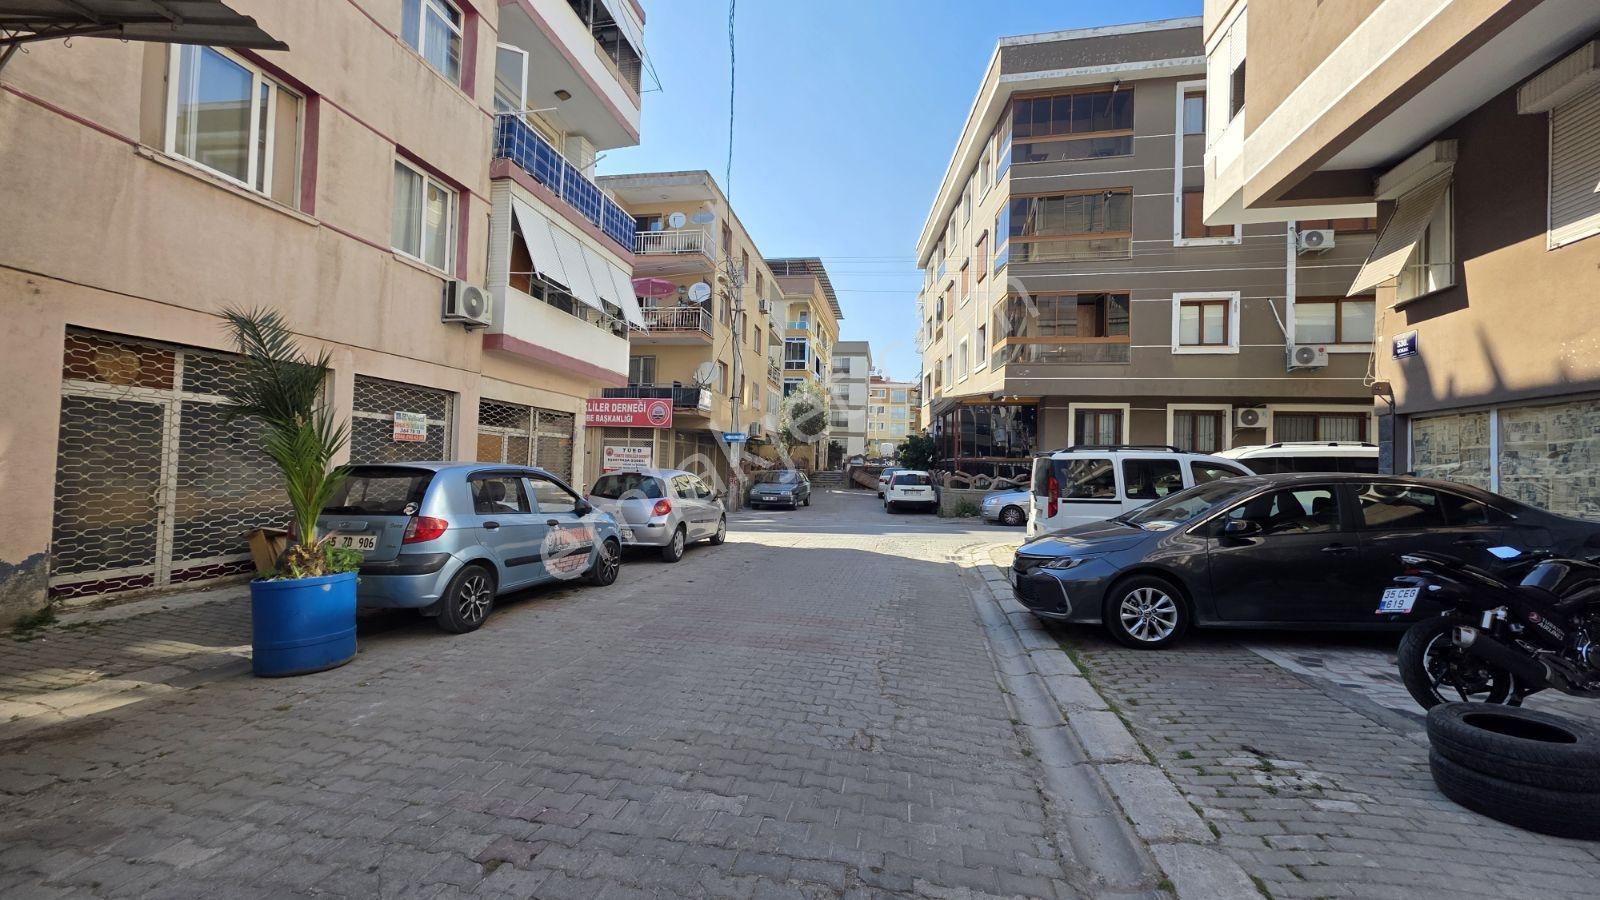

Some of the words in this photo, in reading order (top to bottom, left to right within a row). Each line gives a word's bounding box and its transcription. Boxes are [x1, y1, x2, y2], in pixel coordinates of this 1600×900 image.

[612, 401, 647, 413] DERNEĞİ
[595, 414, 633, 423] BAŞKANLIĞI
[359, 537, 374, 548] 906
[1384, 590, 1396, 599] 35
[1397, 589, 1416, 598] CEG
[1386, 599, 1405, 609] 619
